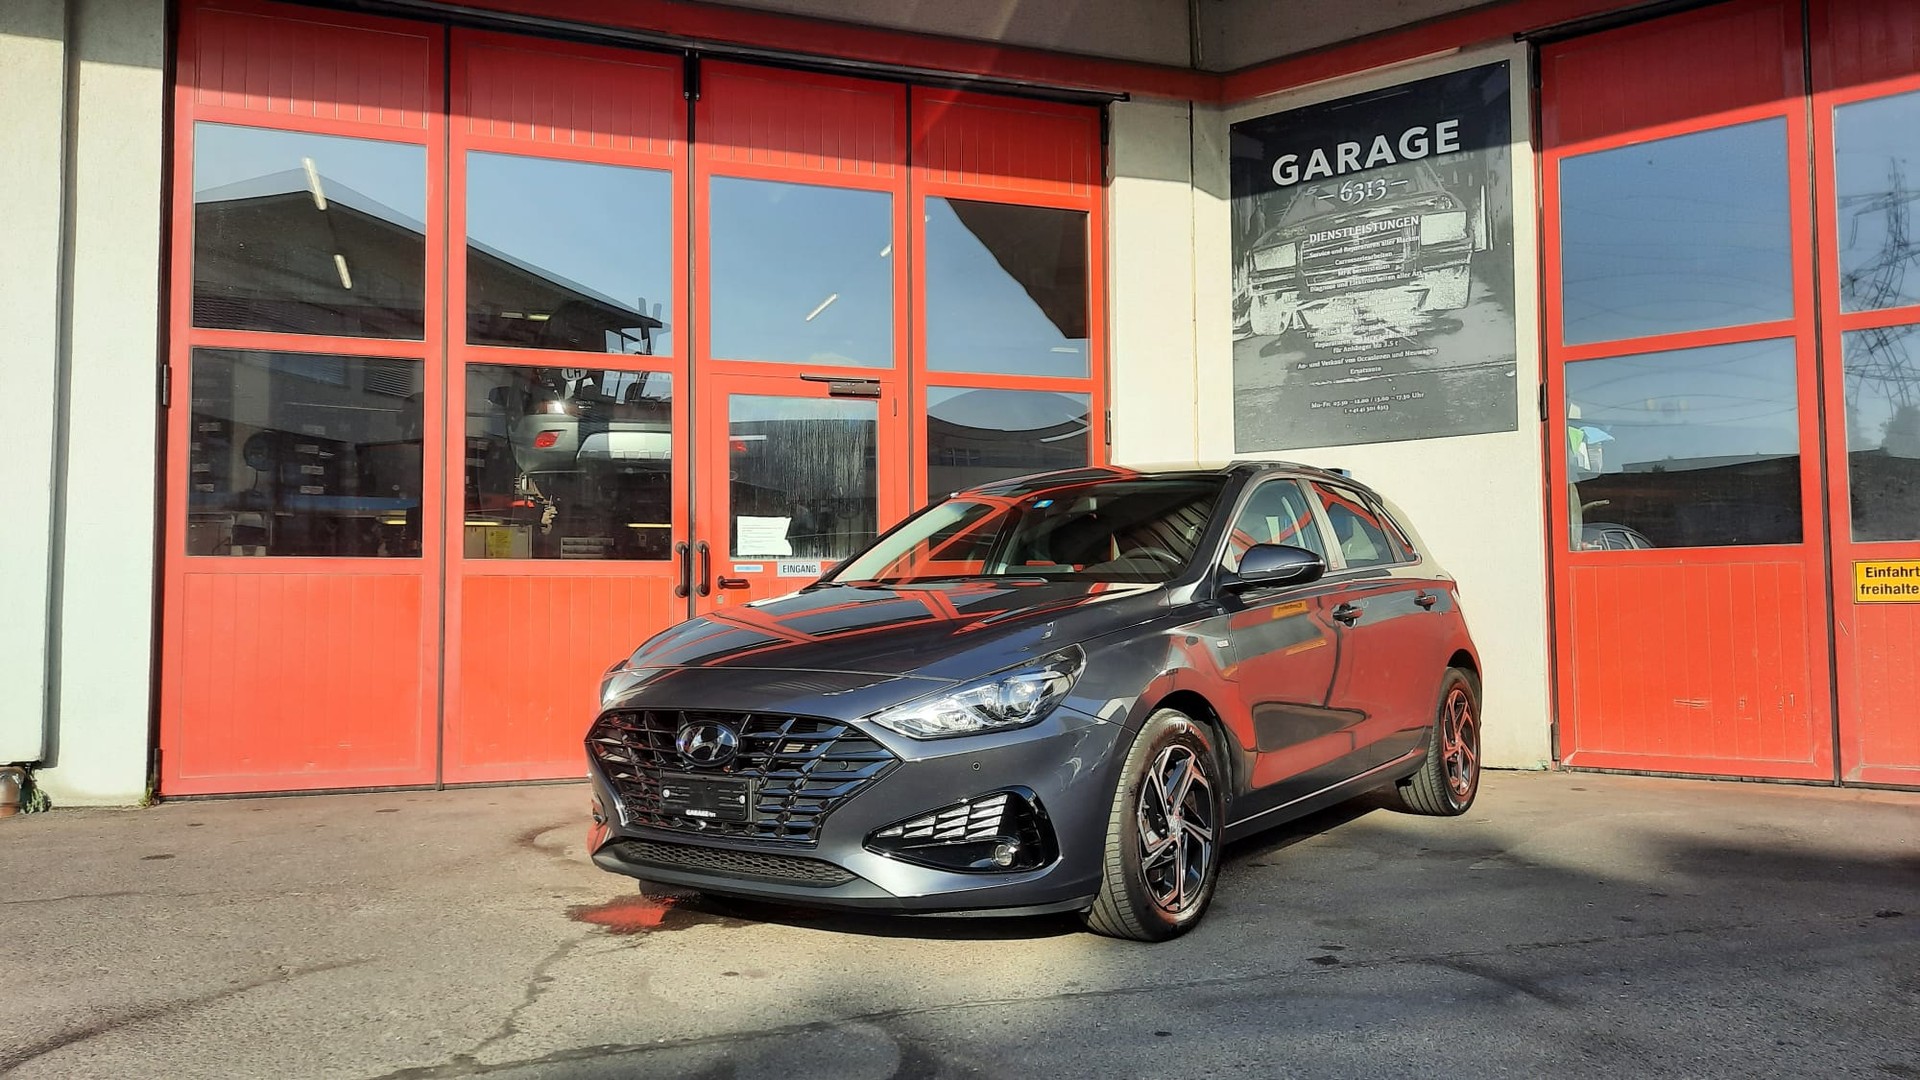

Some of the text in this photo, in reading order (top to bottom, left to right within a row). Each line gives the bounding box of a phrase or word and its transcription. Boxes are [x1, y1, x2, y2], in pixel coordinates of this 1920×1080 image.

[1272, 119, 1460, 186] GARAGE
[1340, 179, 1387, 205] 6313
[1309, 215, 1420, 243] DIENSTLEISTUNGEN
[1321, 358, 1344, 366] Verkauf
[1357, 353, 1390, 361] Occasionen
[1405, 348, 1438, 357] Neuwagen
[1350, 366, 1382, 374] Ersatzauto
[782, 565, 817, 574] EINGANG
[1865, 566, 1920, 578] Einfahrt
